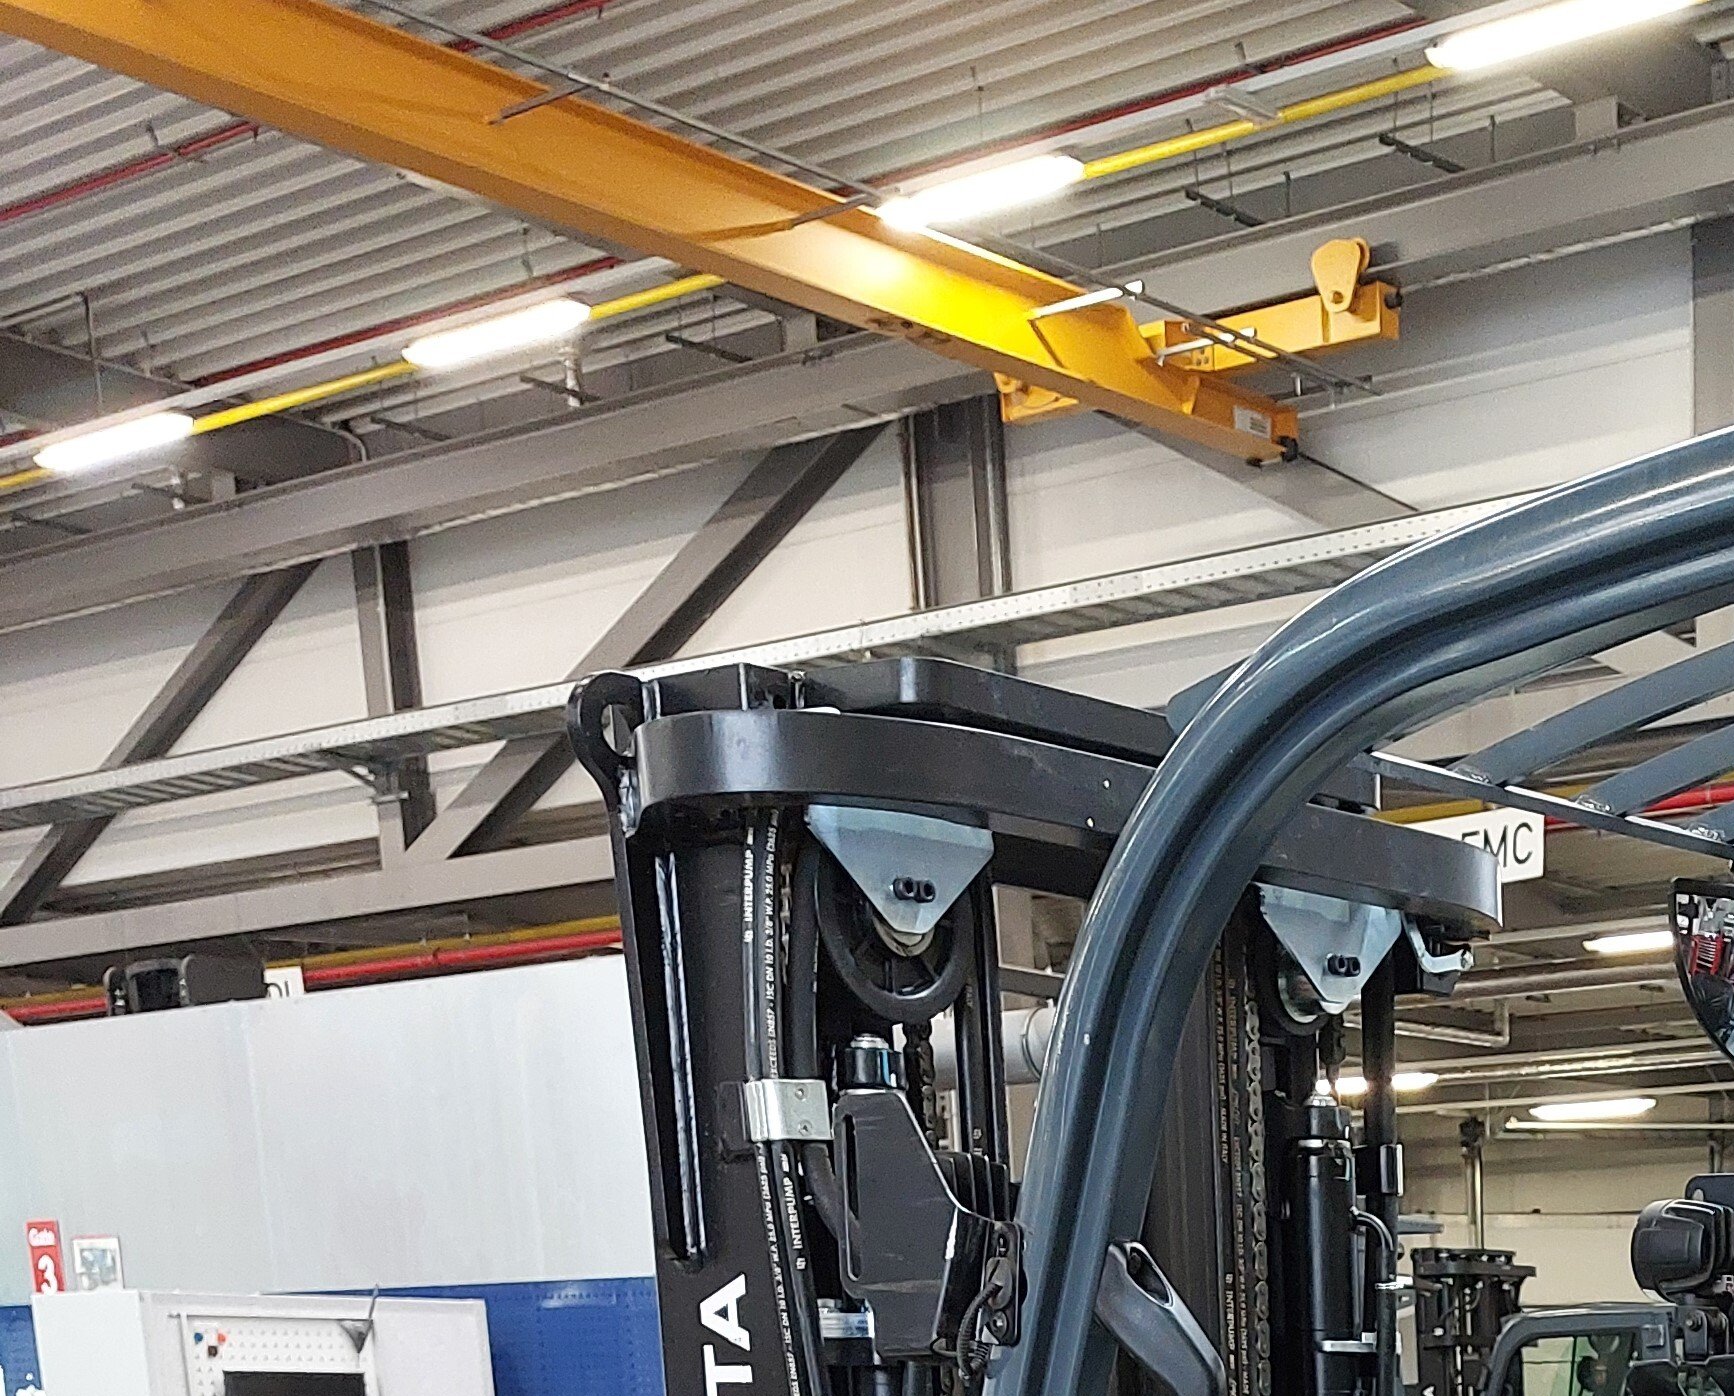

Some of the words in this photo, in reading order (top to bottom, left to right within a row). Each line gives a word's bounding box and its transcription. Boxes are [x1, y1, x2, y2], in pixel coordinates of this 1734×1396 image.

[744, 850, 753, 922] INTERPUMP
[783, 1177, 803, 1249] INTERPUMP
[38, 1254, 59, 1296] 3
